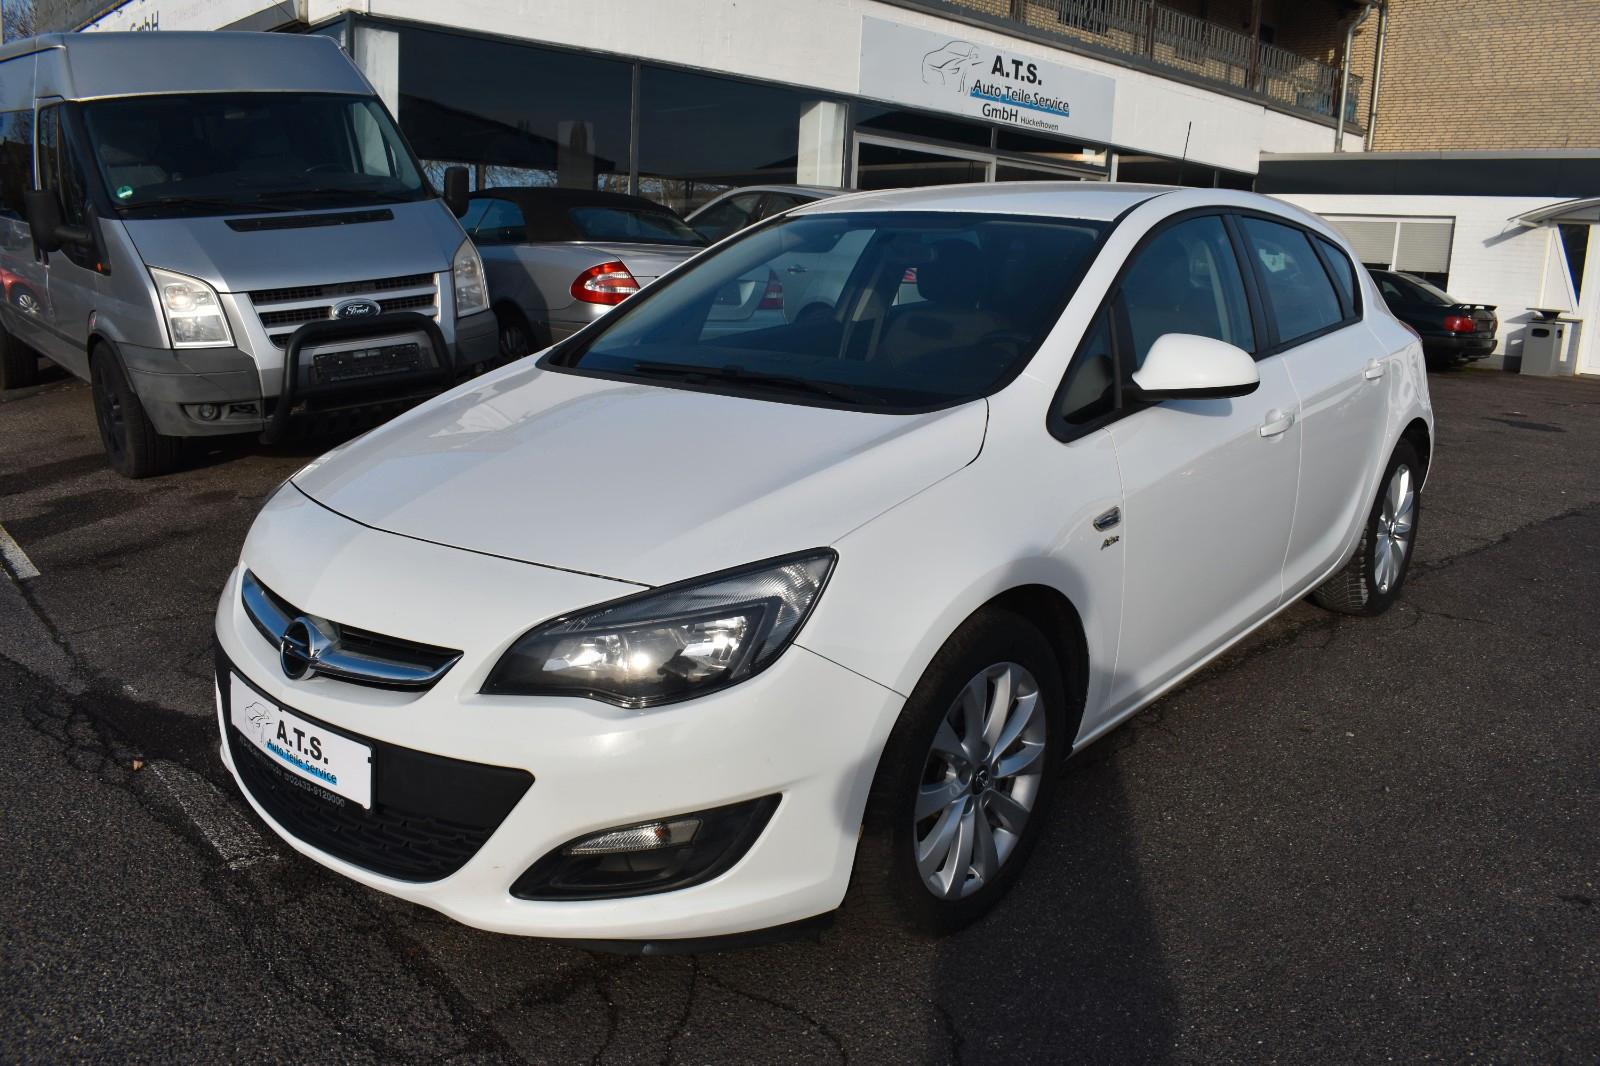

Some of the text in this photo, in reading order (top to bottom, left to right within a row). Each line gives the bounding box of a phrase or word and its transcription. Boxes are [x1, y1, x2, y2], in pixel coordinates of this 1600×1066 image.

[991, 55, 1042, 86] A.T.S.
[973, 79, 1069, 112] Auto Teile Service
[982, 103, 1018, 123] GmbH
[345, 304, 369, 315] Ford
[276, 719, 329, 765] A.T.S.
[267, 738, 284, 756] Auto
[286, 748, 303, 768] Teile
[305, 760, 337, 784] Service
